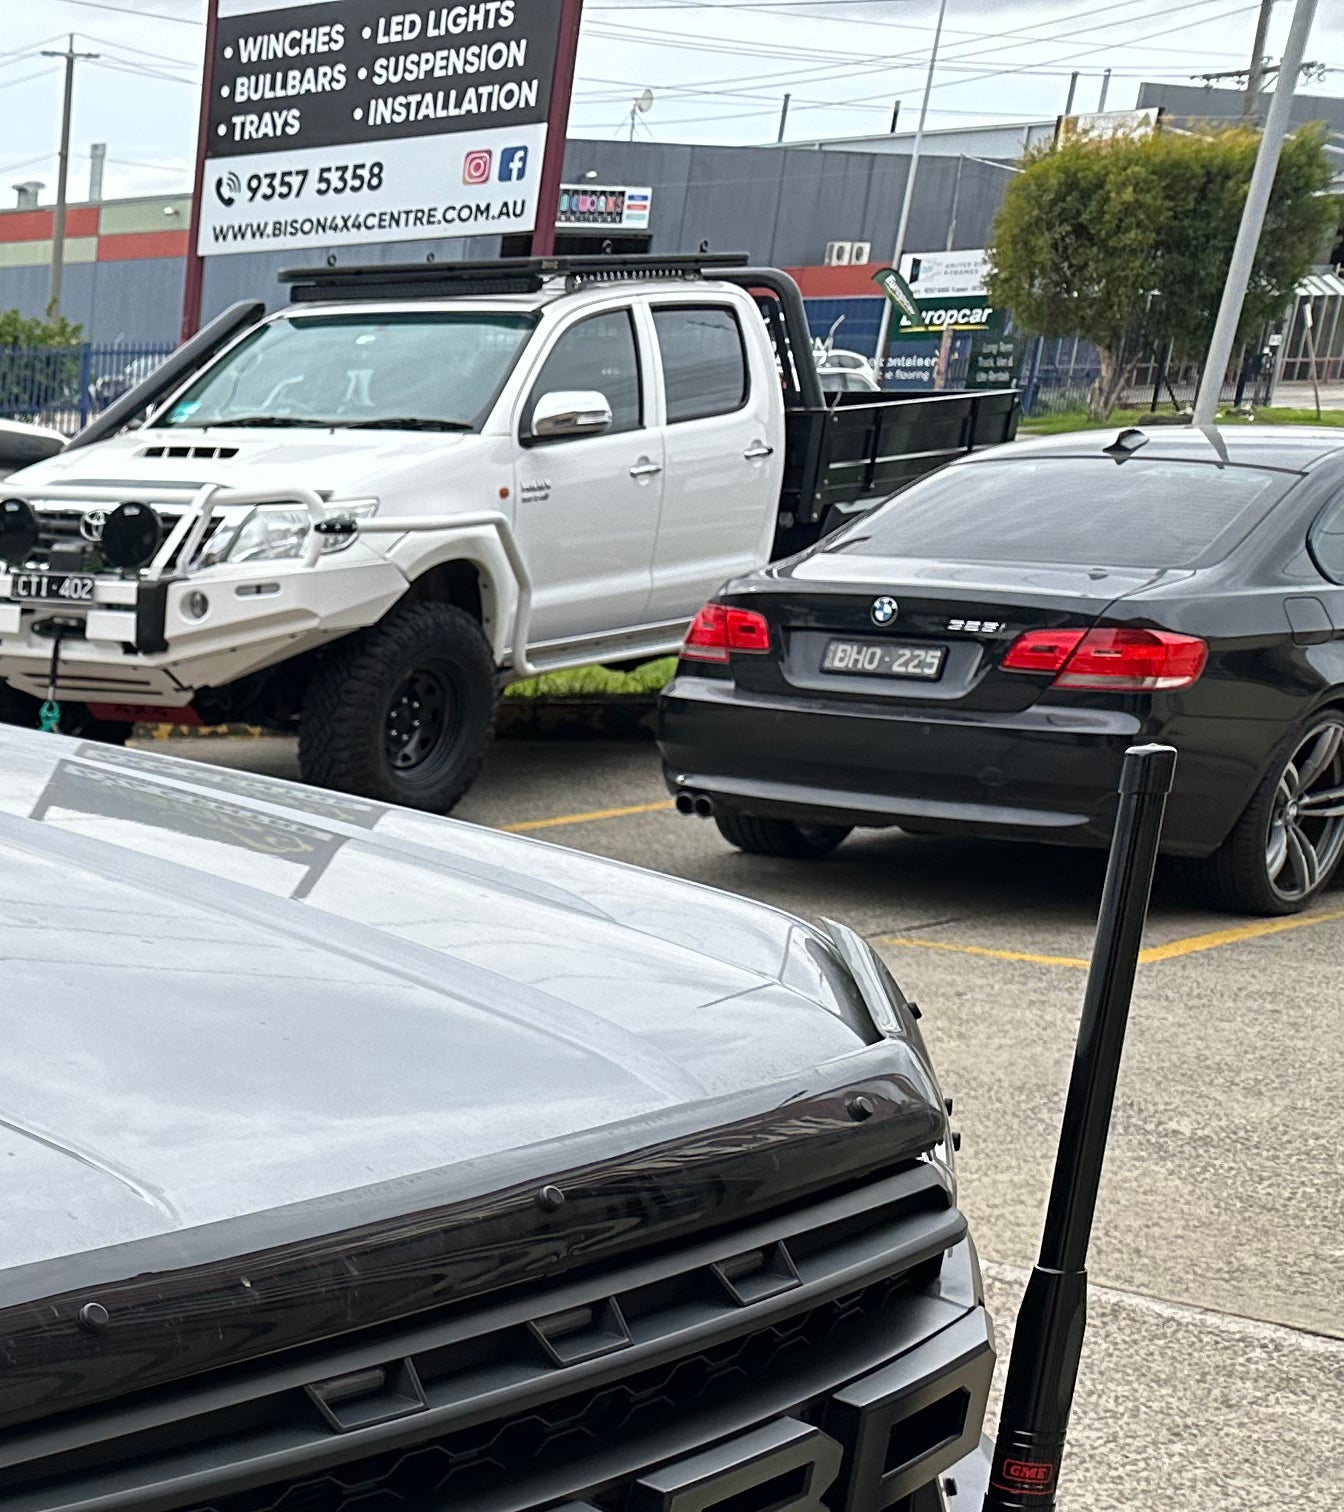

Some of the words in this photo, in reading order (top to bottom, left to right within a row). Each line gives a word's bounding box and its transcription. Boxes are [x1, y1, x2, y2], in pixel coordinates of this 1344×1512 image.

[376, 13, 422, 45] LED
[426, 0, 516, 38] LIGHTS
[238, 23, 345, 64] WINCHES
[372, 38, 528, 86] SUSPENSION
[234, 62, 347, 103] BULLBARS
[367, 78, 539, 126] INSTALLATION
[231, 107, 301, 141] TRAYS
[246, 168, 309, 203] 9357
[315, 161, 385, 196] 5358
[212, 199, 527, 243] WWW.BISON4X4CENTRE.COM.AU
[899, 307, 994, 328] ropcar
[1009, 1464, 1048, 1480] GME
